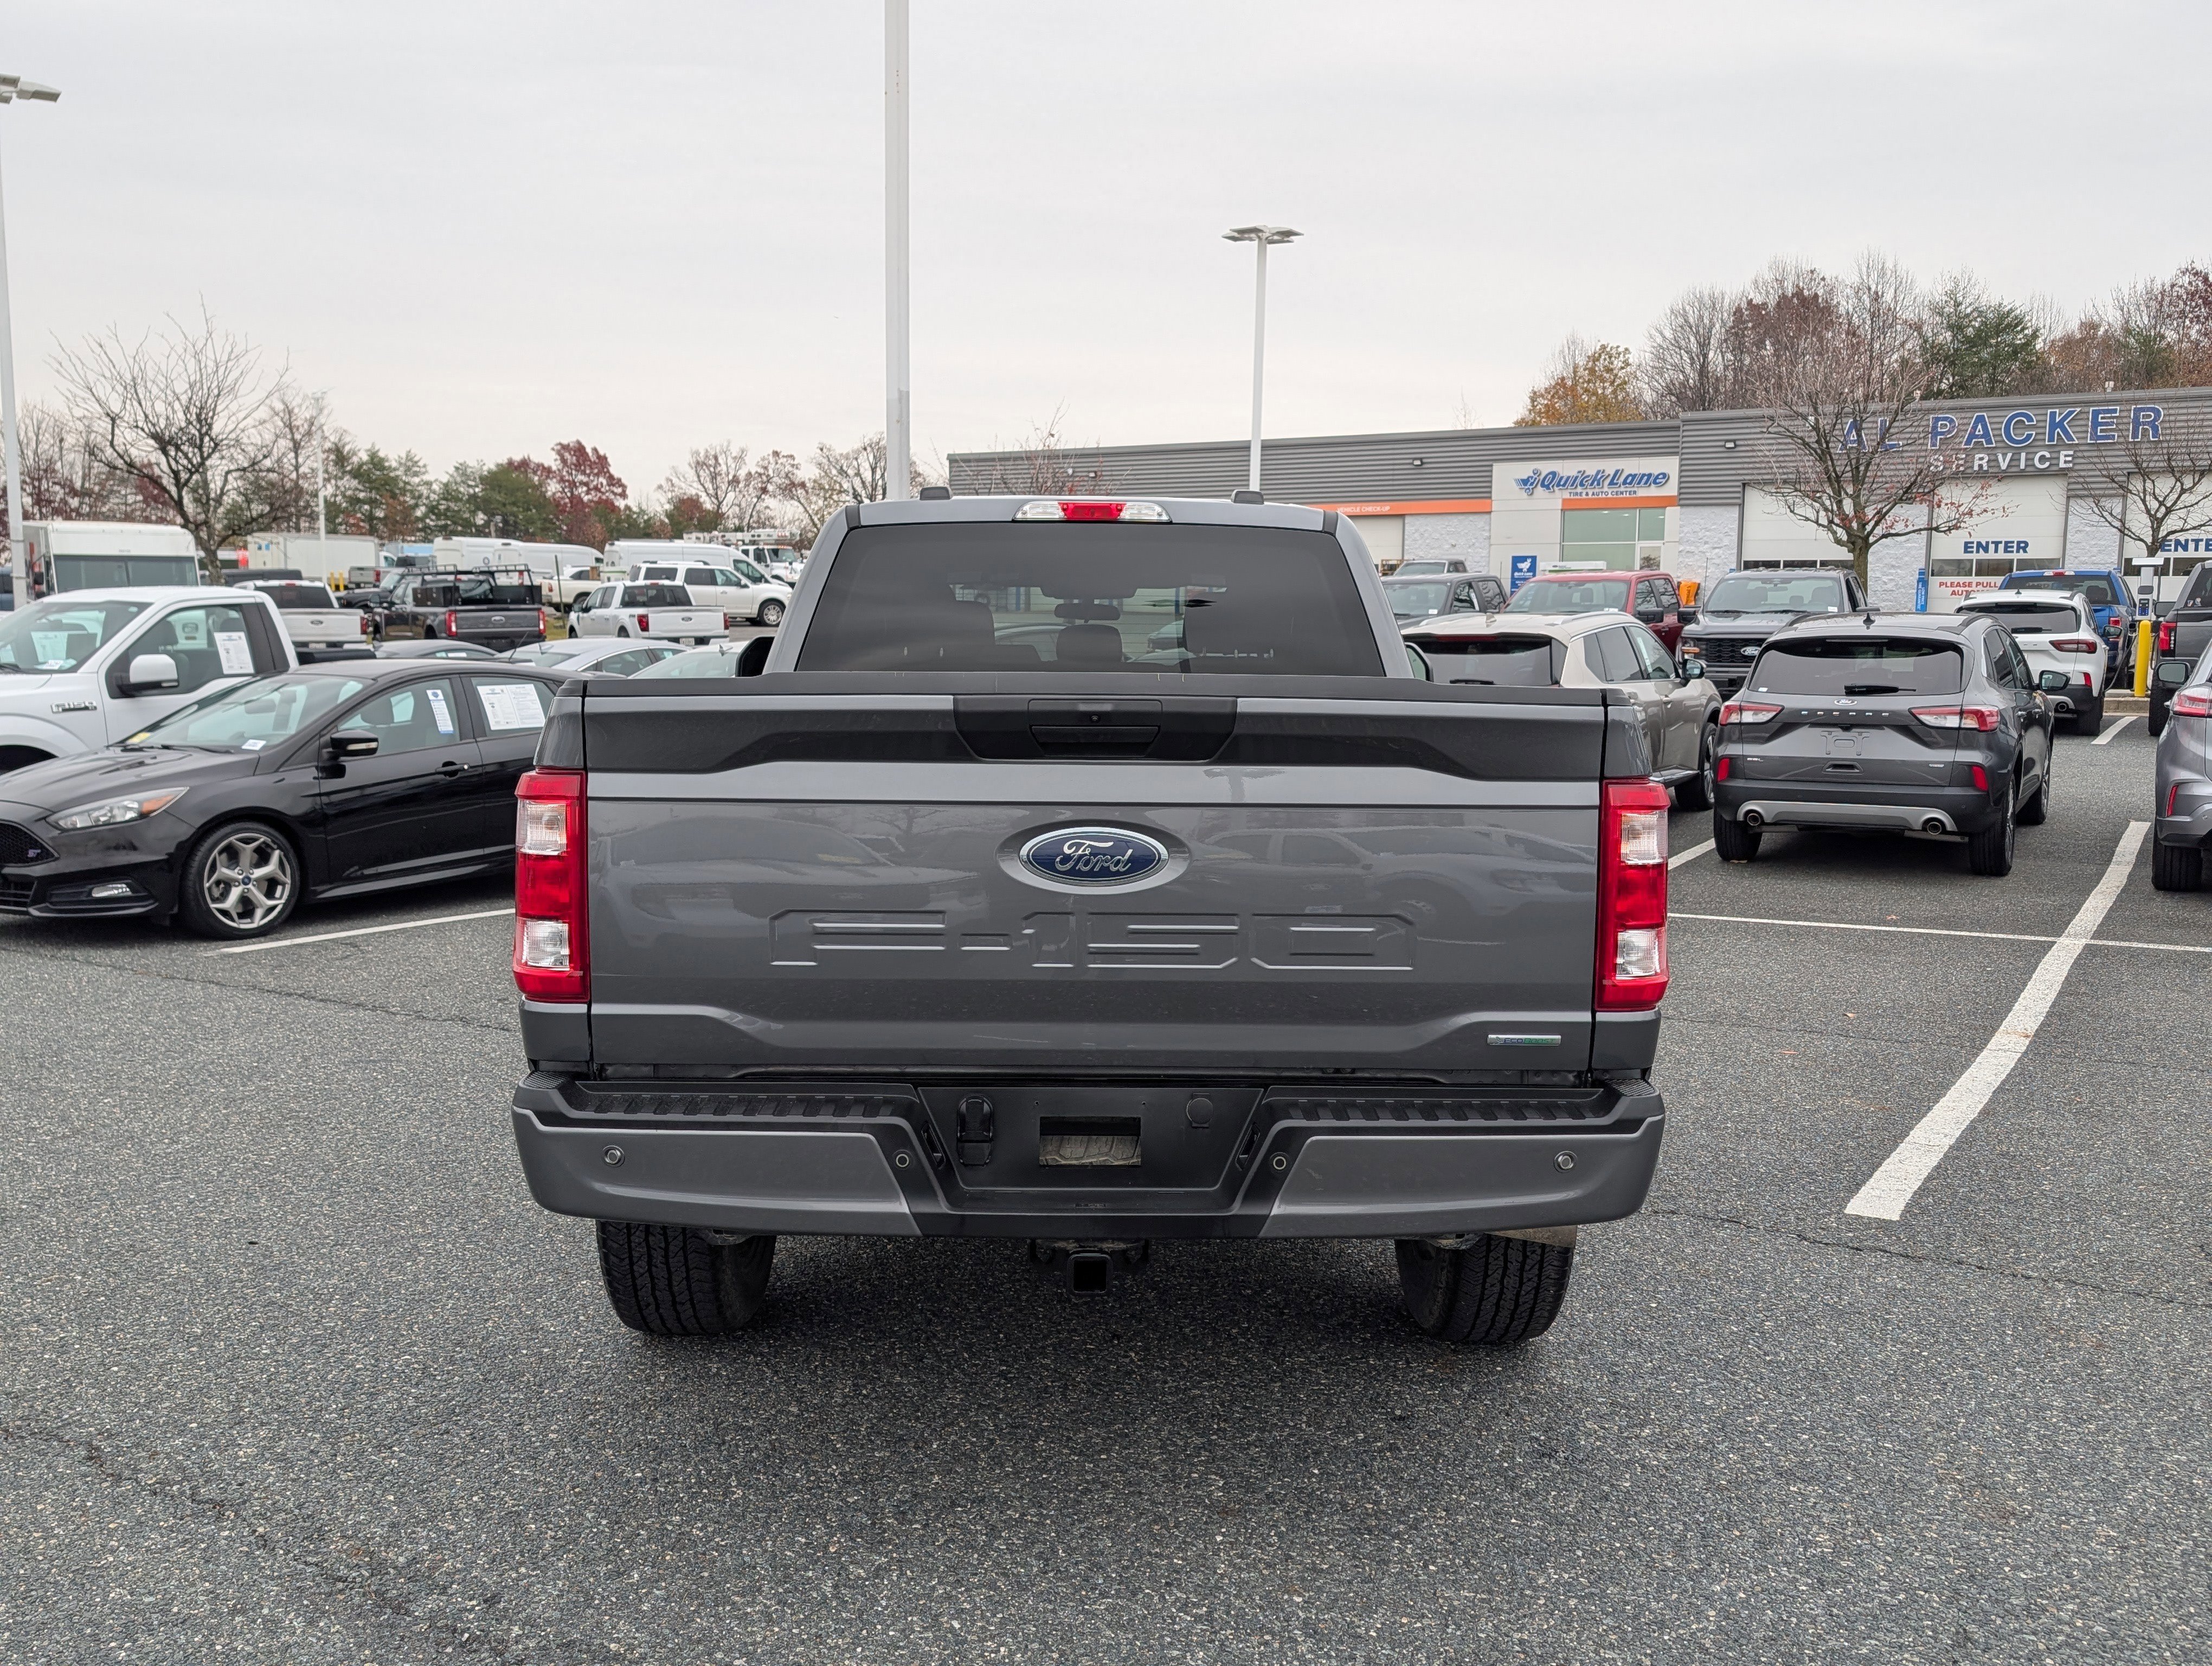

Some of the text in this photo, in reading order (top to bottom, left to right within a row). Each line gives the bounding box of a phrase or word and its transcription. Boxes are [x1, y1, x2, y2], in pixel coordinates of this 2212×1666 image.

[1837, 405, 2164, 453] AL PACKER
[1930, 451, 2074, 472] SERVICE
[1540, 469, 1669, 492] Quick Lane
[1963, 540, 2029, 554] ENTER
[1055, 840, 1133, 872] Ford
[768, 909, 1413, 971] F-150
